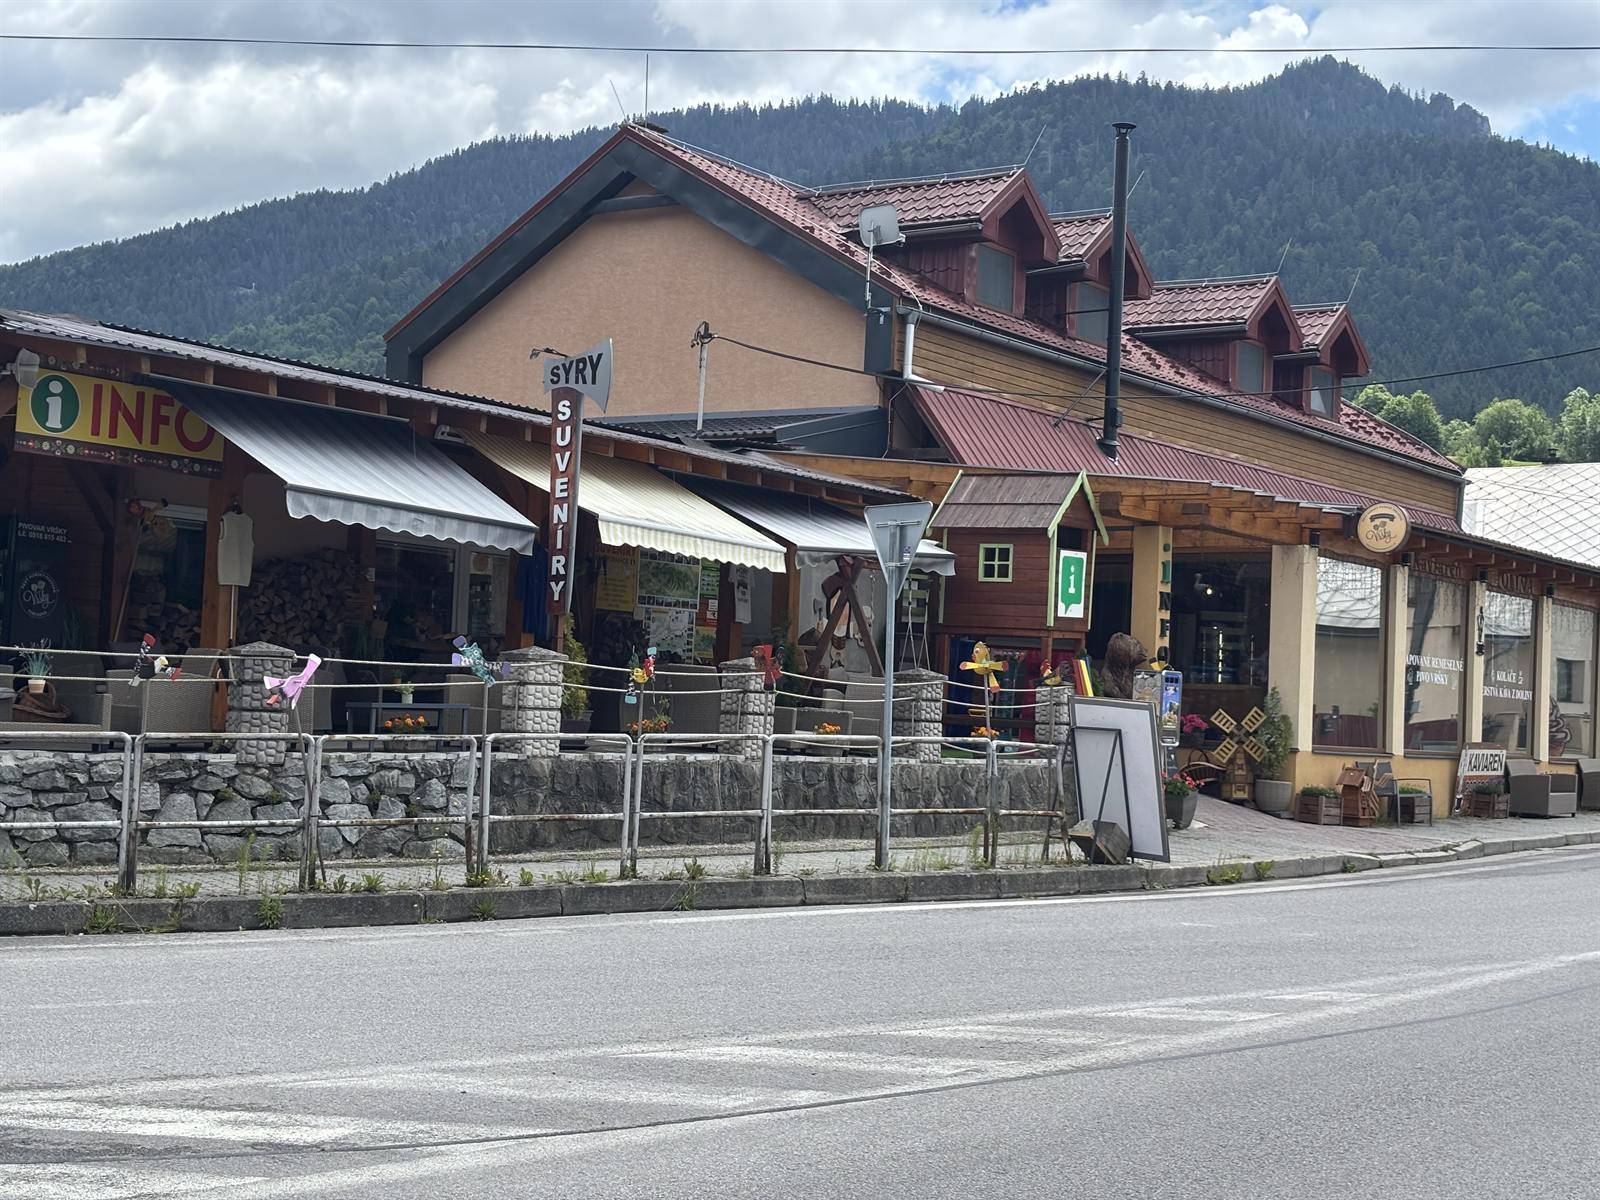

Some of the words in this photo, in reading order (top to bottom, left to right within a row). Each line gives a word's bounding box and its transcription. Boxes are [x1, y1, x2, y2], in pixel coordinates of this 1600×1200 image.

[549, 352, 604, 386] SYRY
[90, 383, 215, 452] INFO
[549, 399, 572, 601] SUVENÍRY
